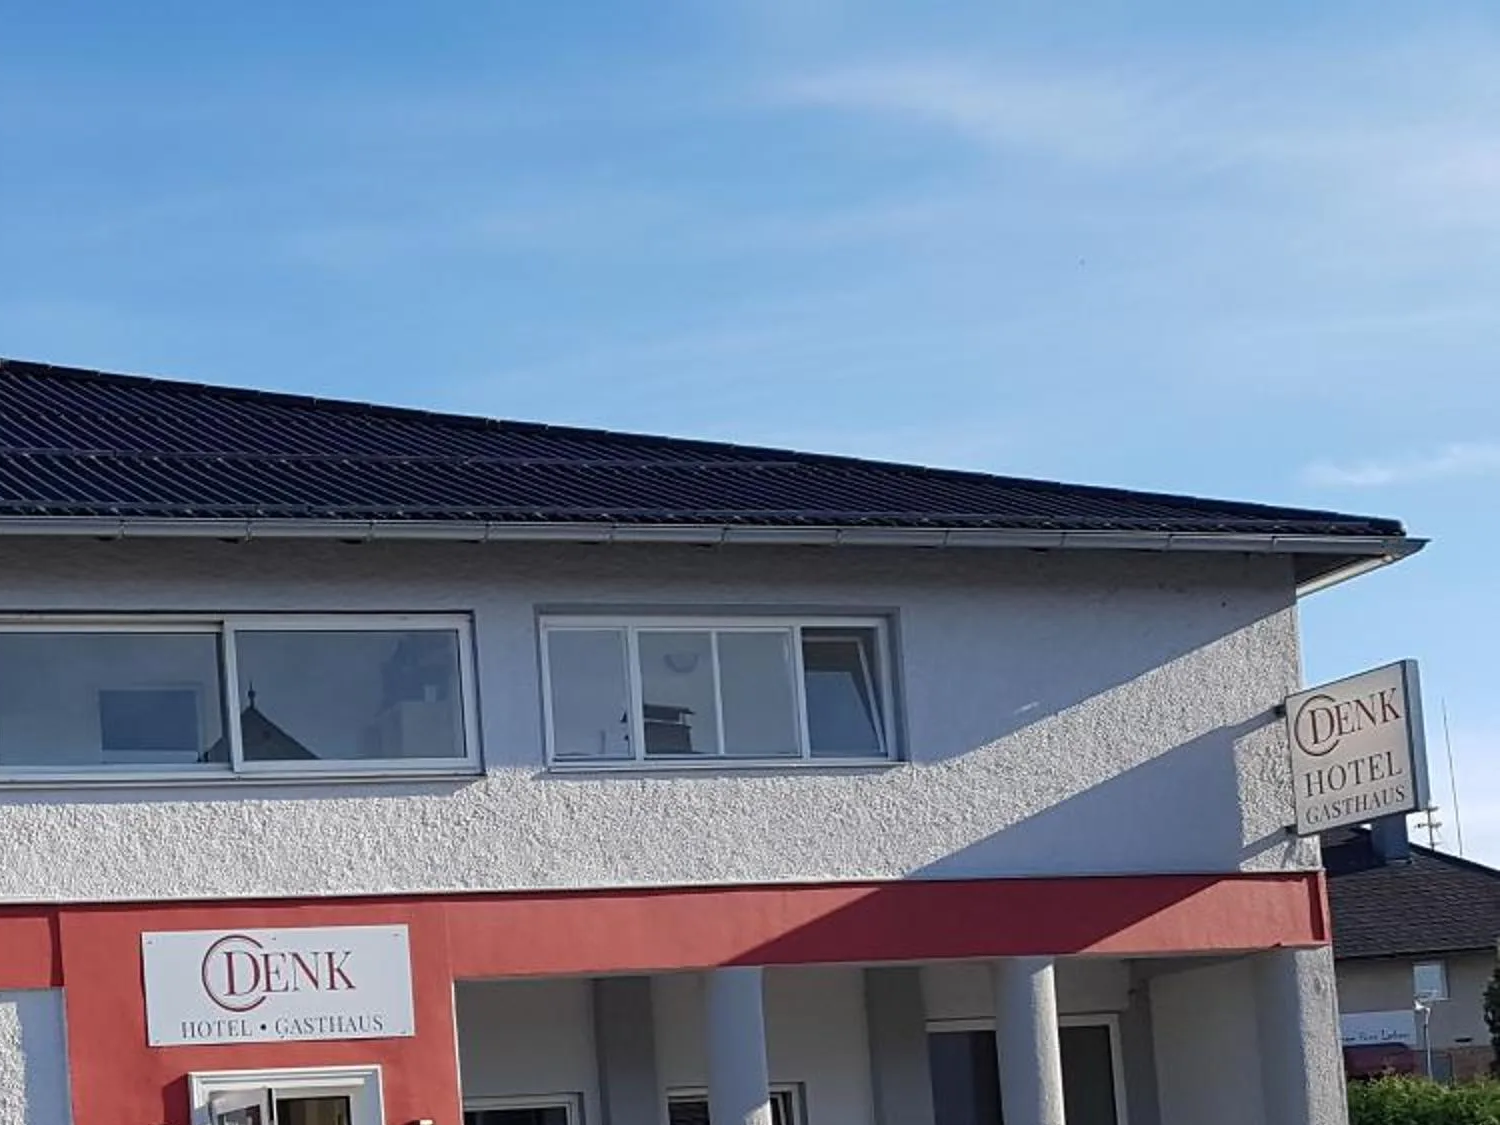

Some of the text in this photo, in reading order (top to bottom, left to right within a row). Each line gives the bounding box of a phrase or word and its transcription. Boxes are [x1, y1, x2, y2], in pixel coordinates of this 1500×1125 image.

[1307, 687, 1403, 745] DENK
[1304, 751, 1402, 798] HOTEL
[1306, 785, 1405, 826] GASTHAUS
[221, 948, 357, 998] DENK
[181, 1014, 384, 1039] HOTEL GASTHAUS
